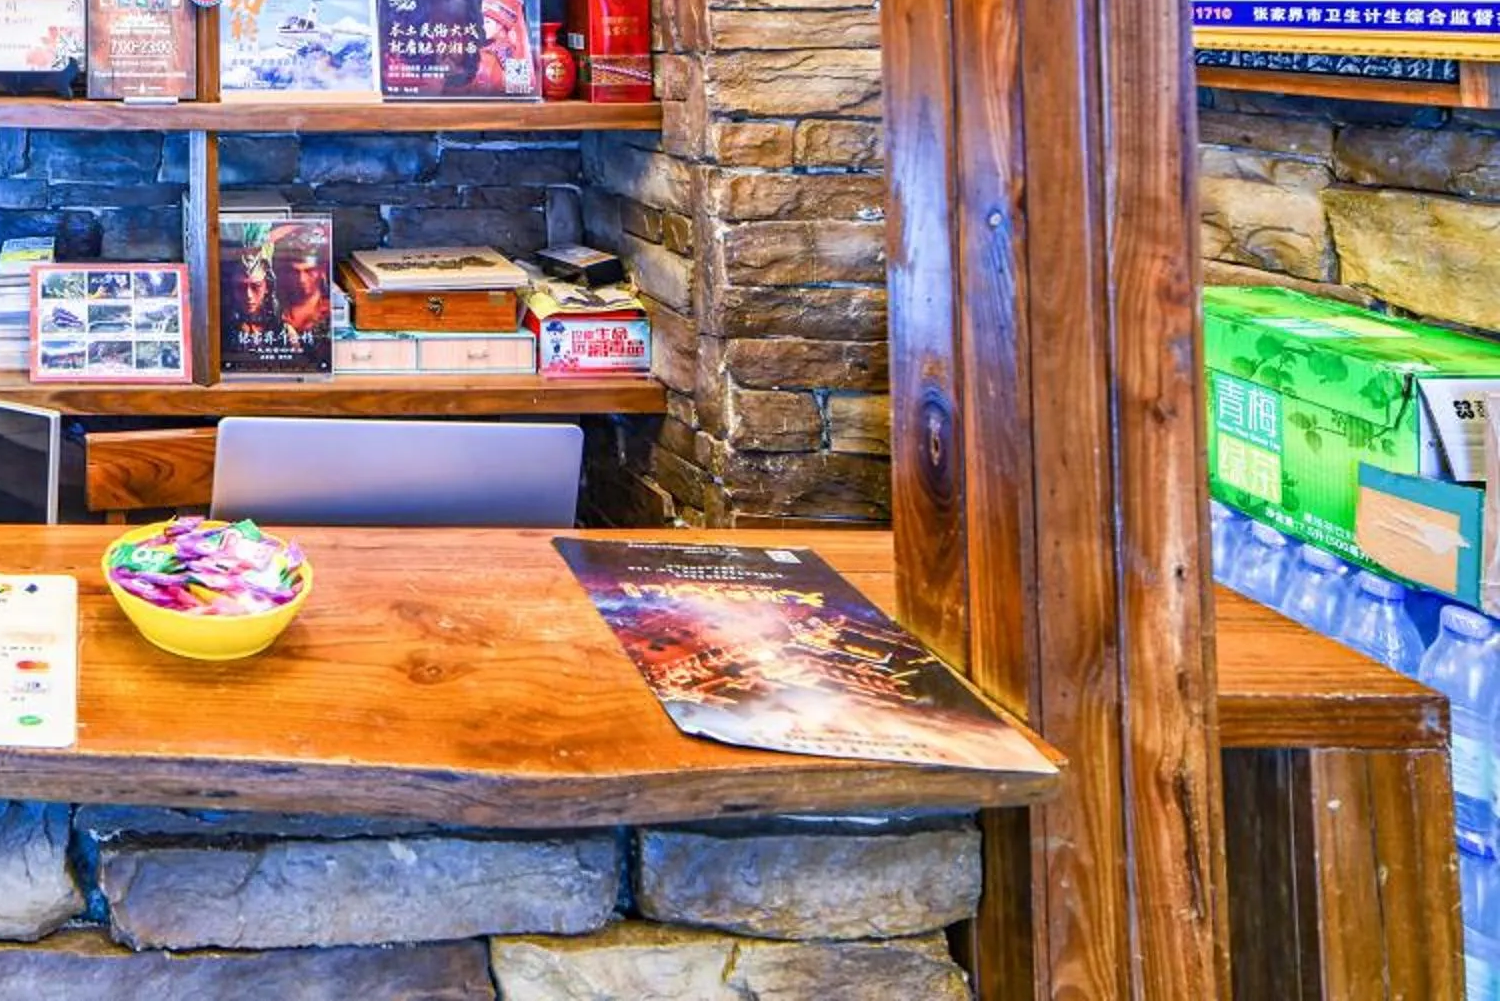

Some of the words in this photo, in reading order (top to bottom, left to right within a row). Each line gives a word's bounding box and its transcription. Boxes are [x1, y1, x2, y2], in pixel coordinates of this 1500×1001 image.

[1190, 7, 1233, 21] 1710
[1253, 6, 1500, 27] 张家界市卫生计生综合监督
